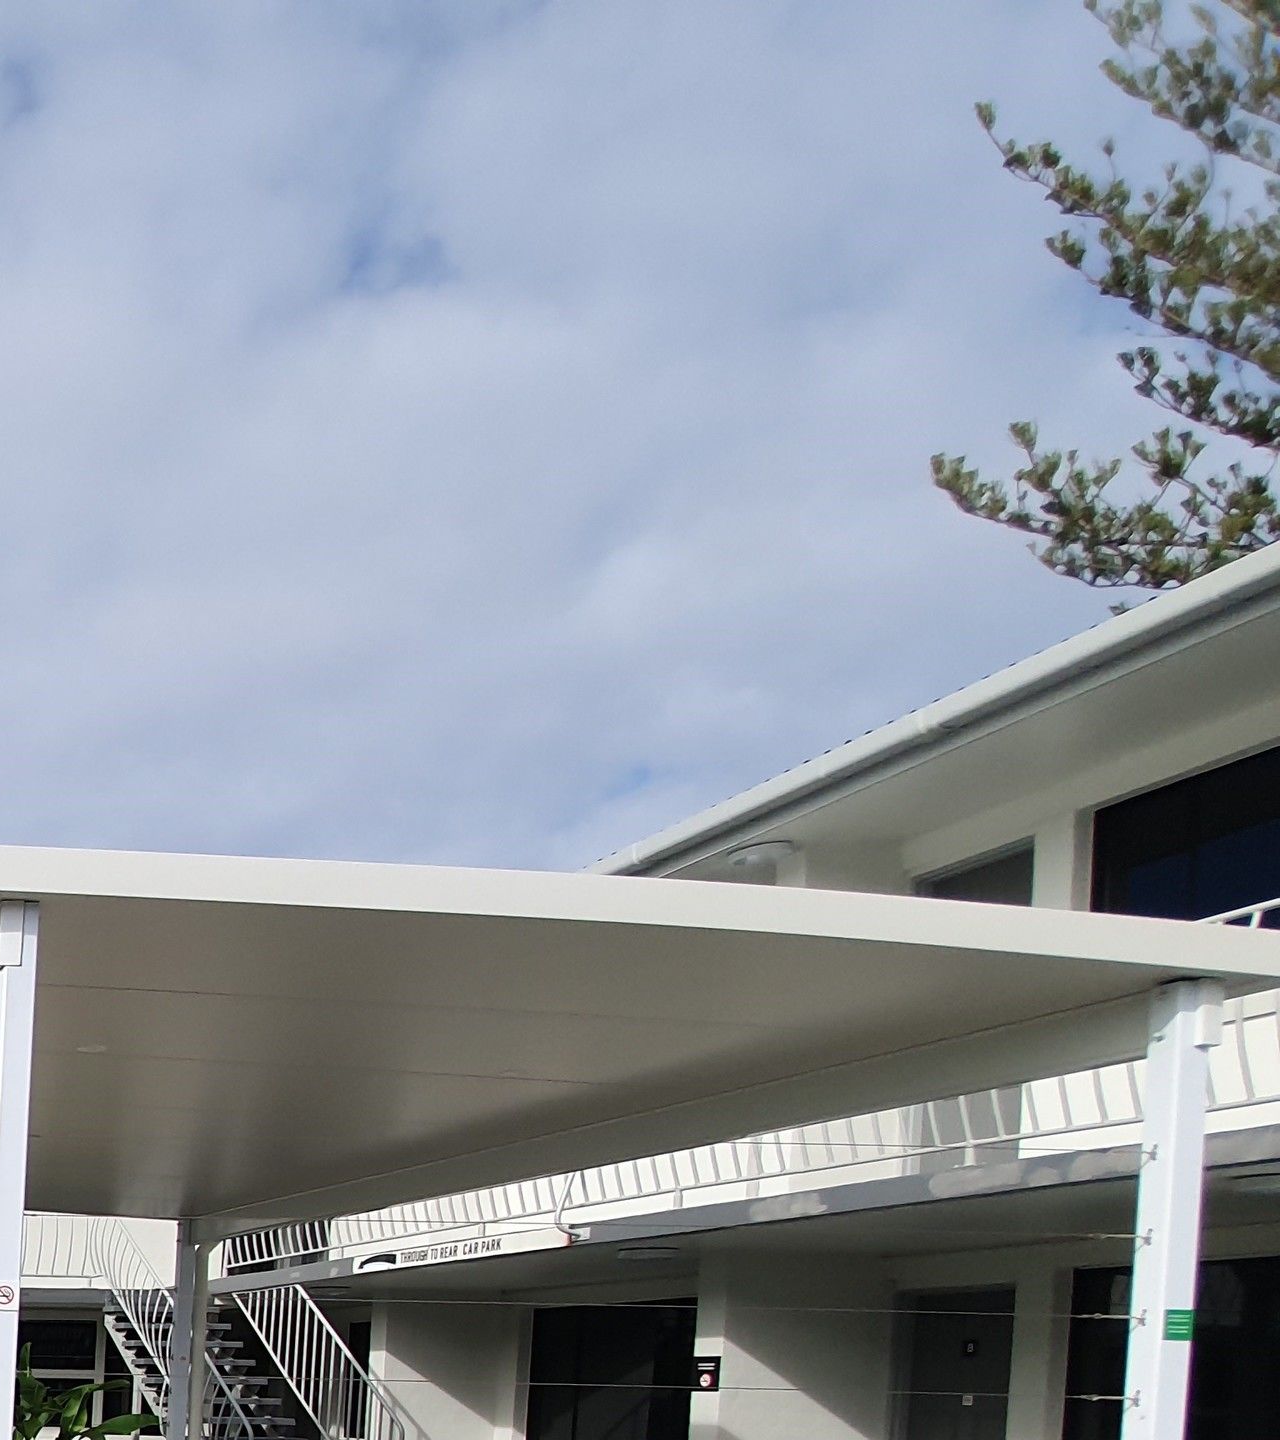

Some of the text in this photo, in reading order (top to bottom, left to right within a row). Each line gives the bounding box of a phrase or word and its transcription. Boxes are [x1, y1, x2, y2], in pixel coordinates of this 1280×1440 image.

[400, 1239, 502, 1264] THROUGH TO REAR CAR PARK
